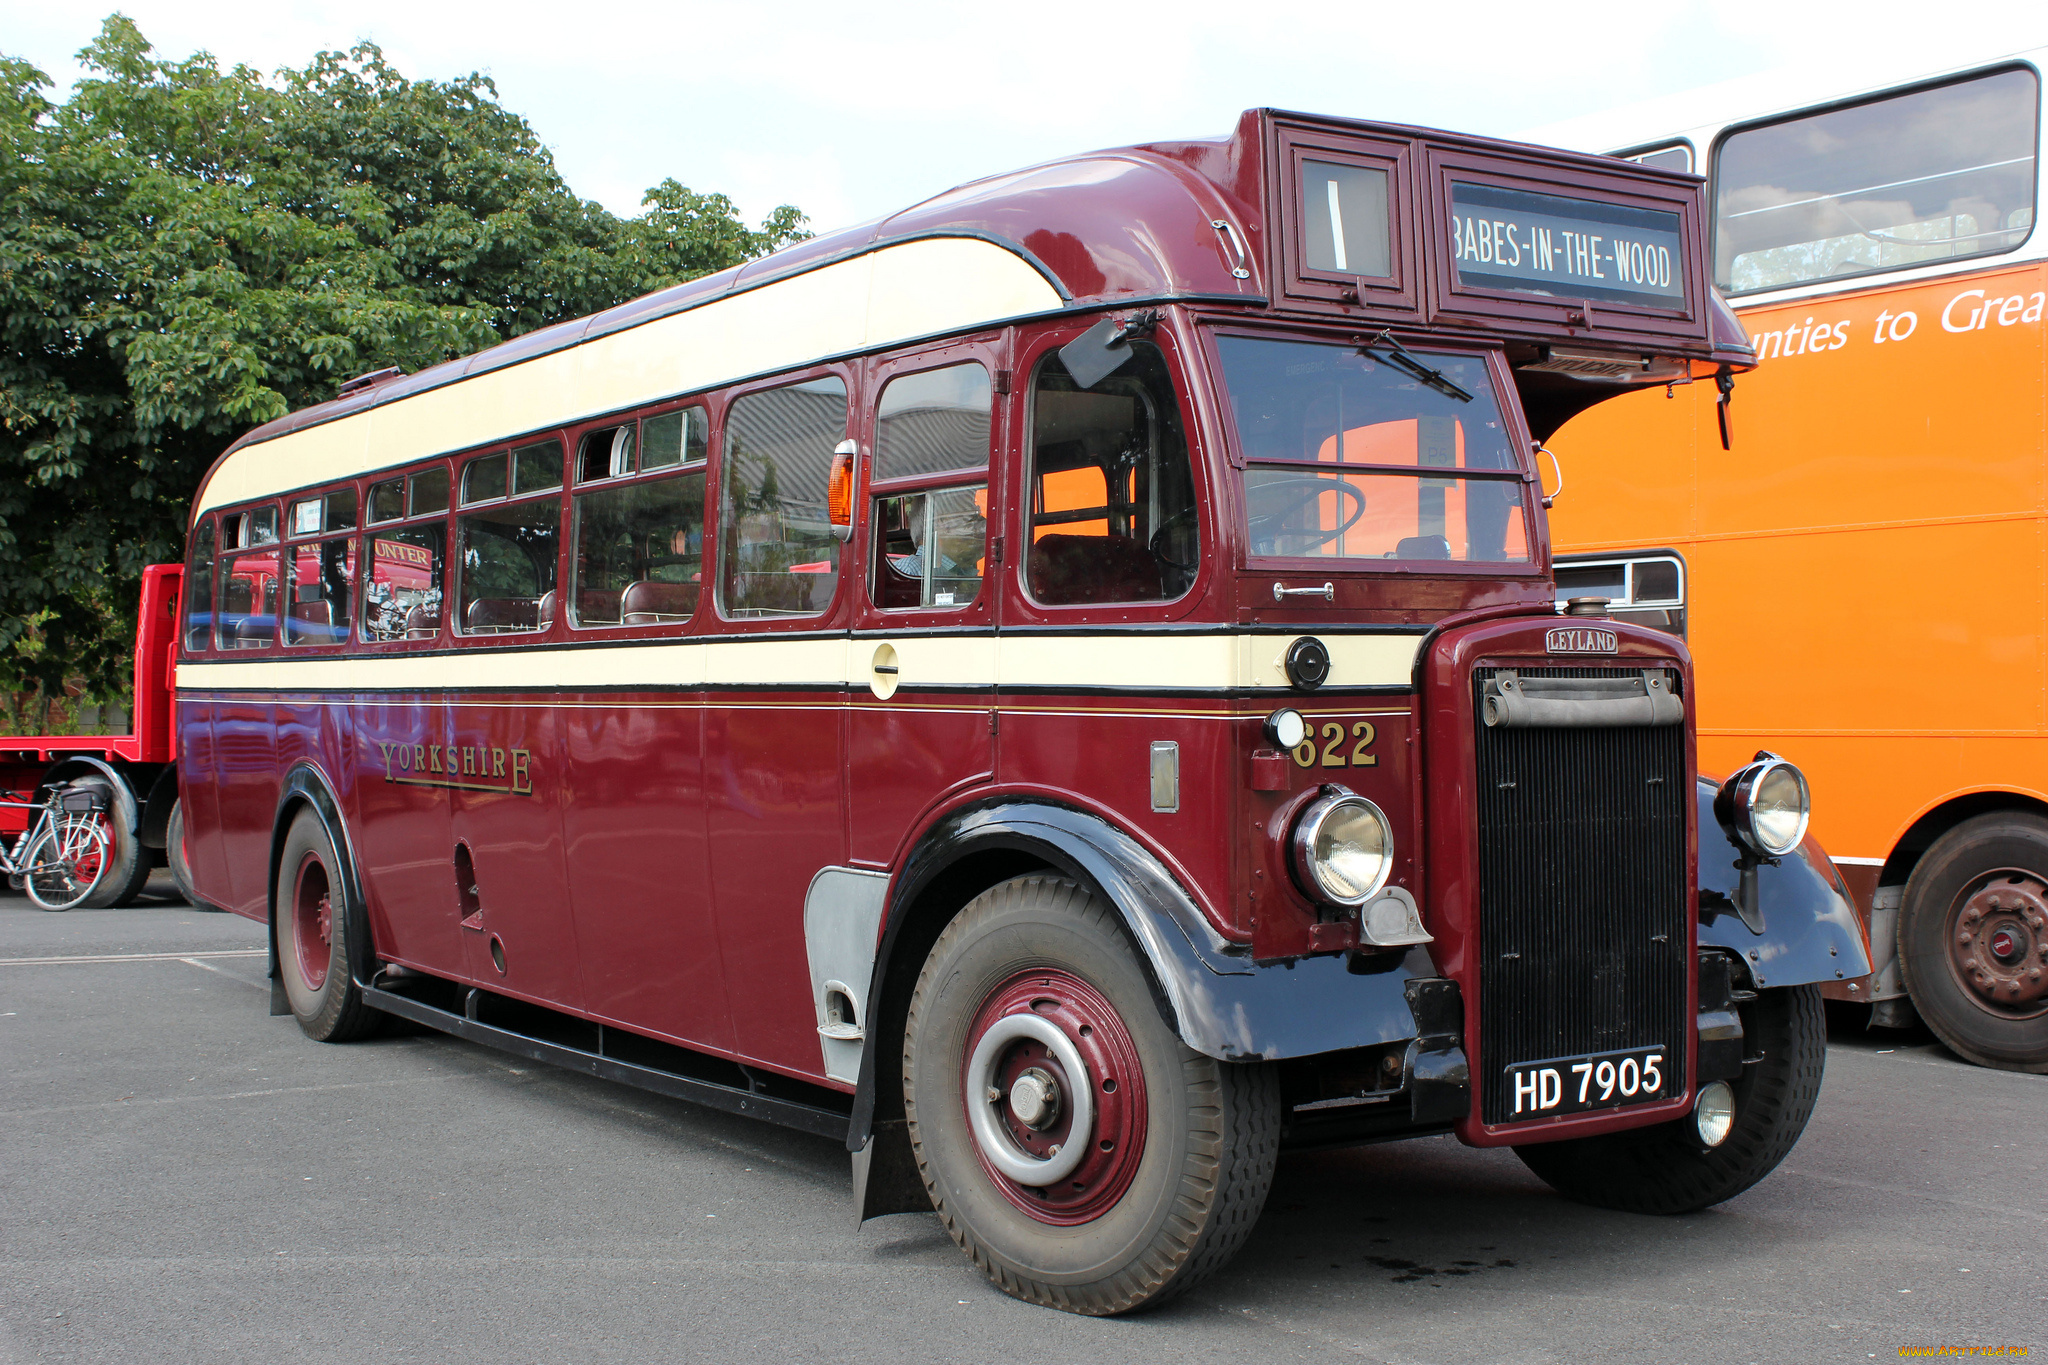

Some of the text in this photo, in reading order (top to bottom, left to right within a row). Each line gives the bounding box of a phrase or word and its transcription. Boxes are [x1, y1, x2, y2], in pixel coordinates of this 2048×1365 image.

[1327, 180, 1347, 270] 1
[1453, 215, 1671, 288] BABES-IN-THE-WOOD
[1873, 308, 1919, 344] to
[1428, 446, 1448, 465] P5
[1549, 630, 1616, 651] LEYLAND
[379, 742, 532, 796] YORKSHIRE
[1292, 721, 1378, 768] 622
[1514, 1054, 1664, 1114] HD 7905
